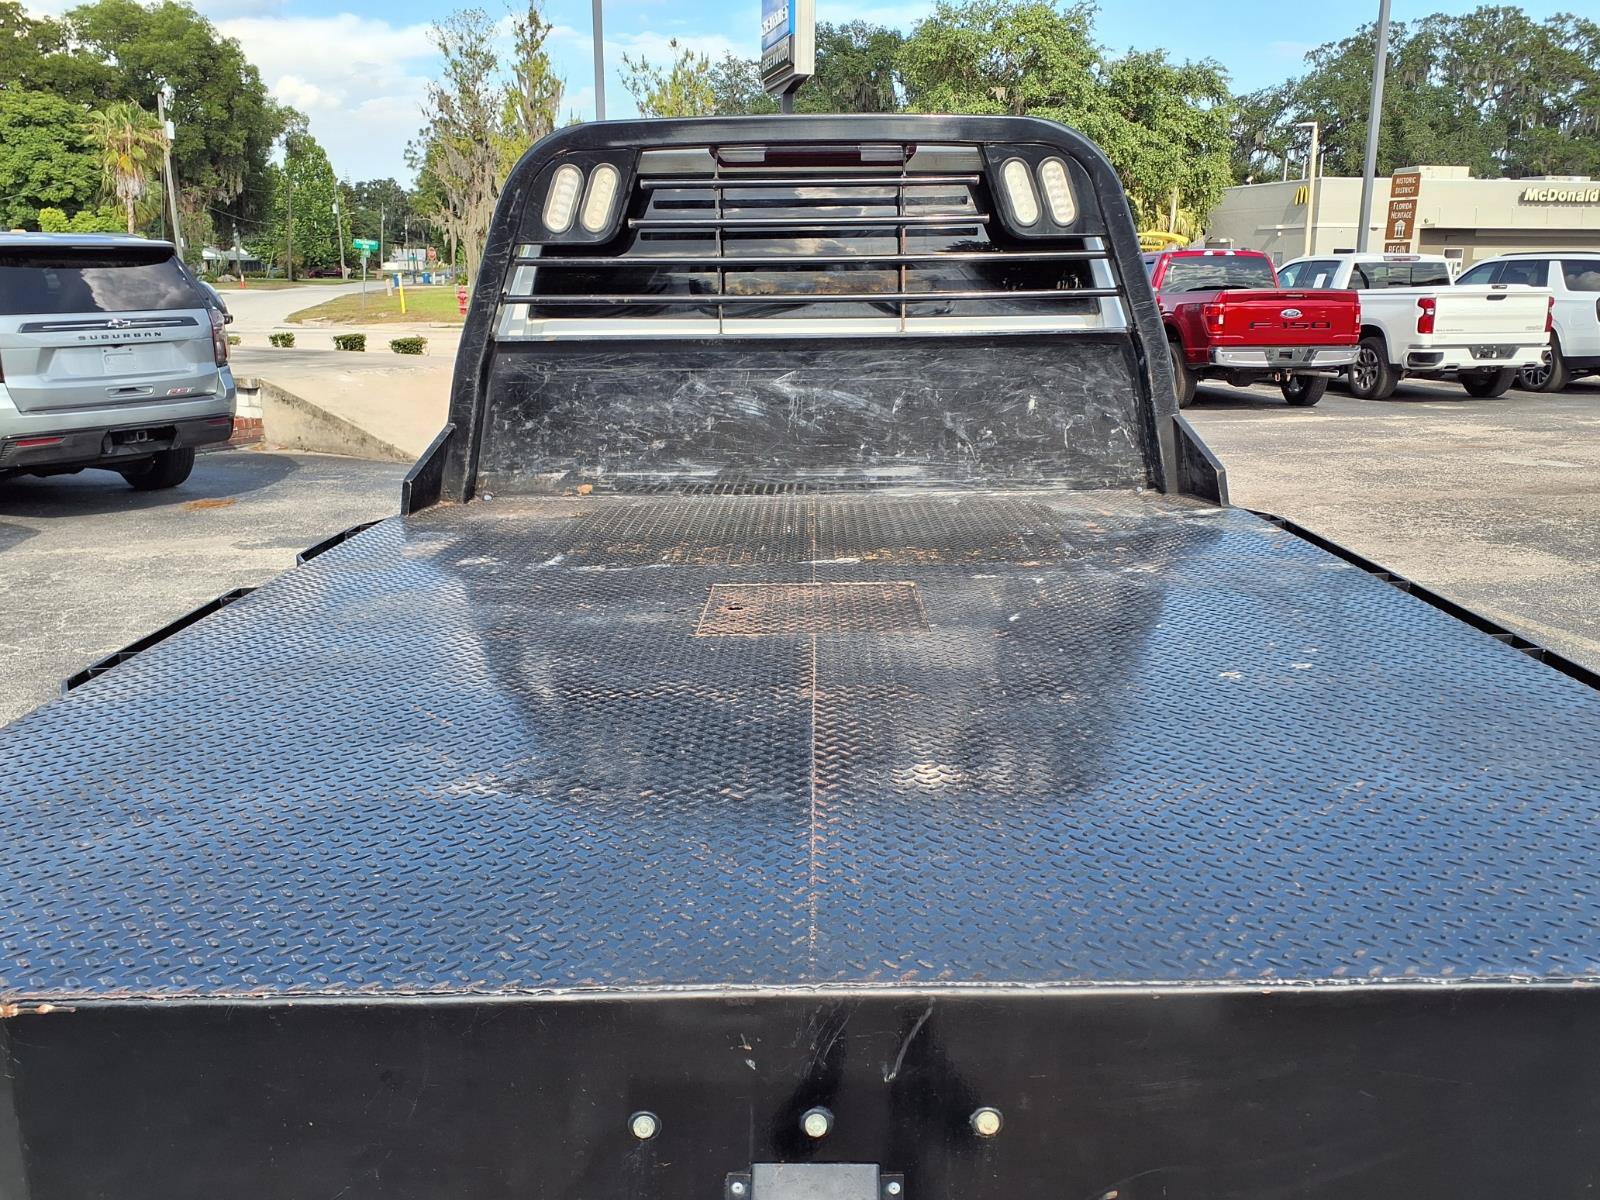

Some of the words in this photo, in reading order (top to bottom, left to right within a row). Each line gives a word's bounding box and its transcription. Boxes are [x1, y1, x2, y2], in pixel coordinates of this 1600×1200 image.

[1396, 177, 1416, 185] HISTORIC
[1523, 188, 1600, 202] McDonald
[1388, 245, 1407, 253] BEGIN
[1249, 321, 1333, 331] F-150
[78, 331, 162, 341] SUBURBAN
